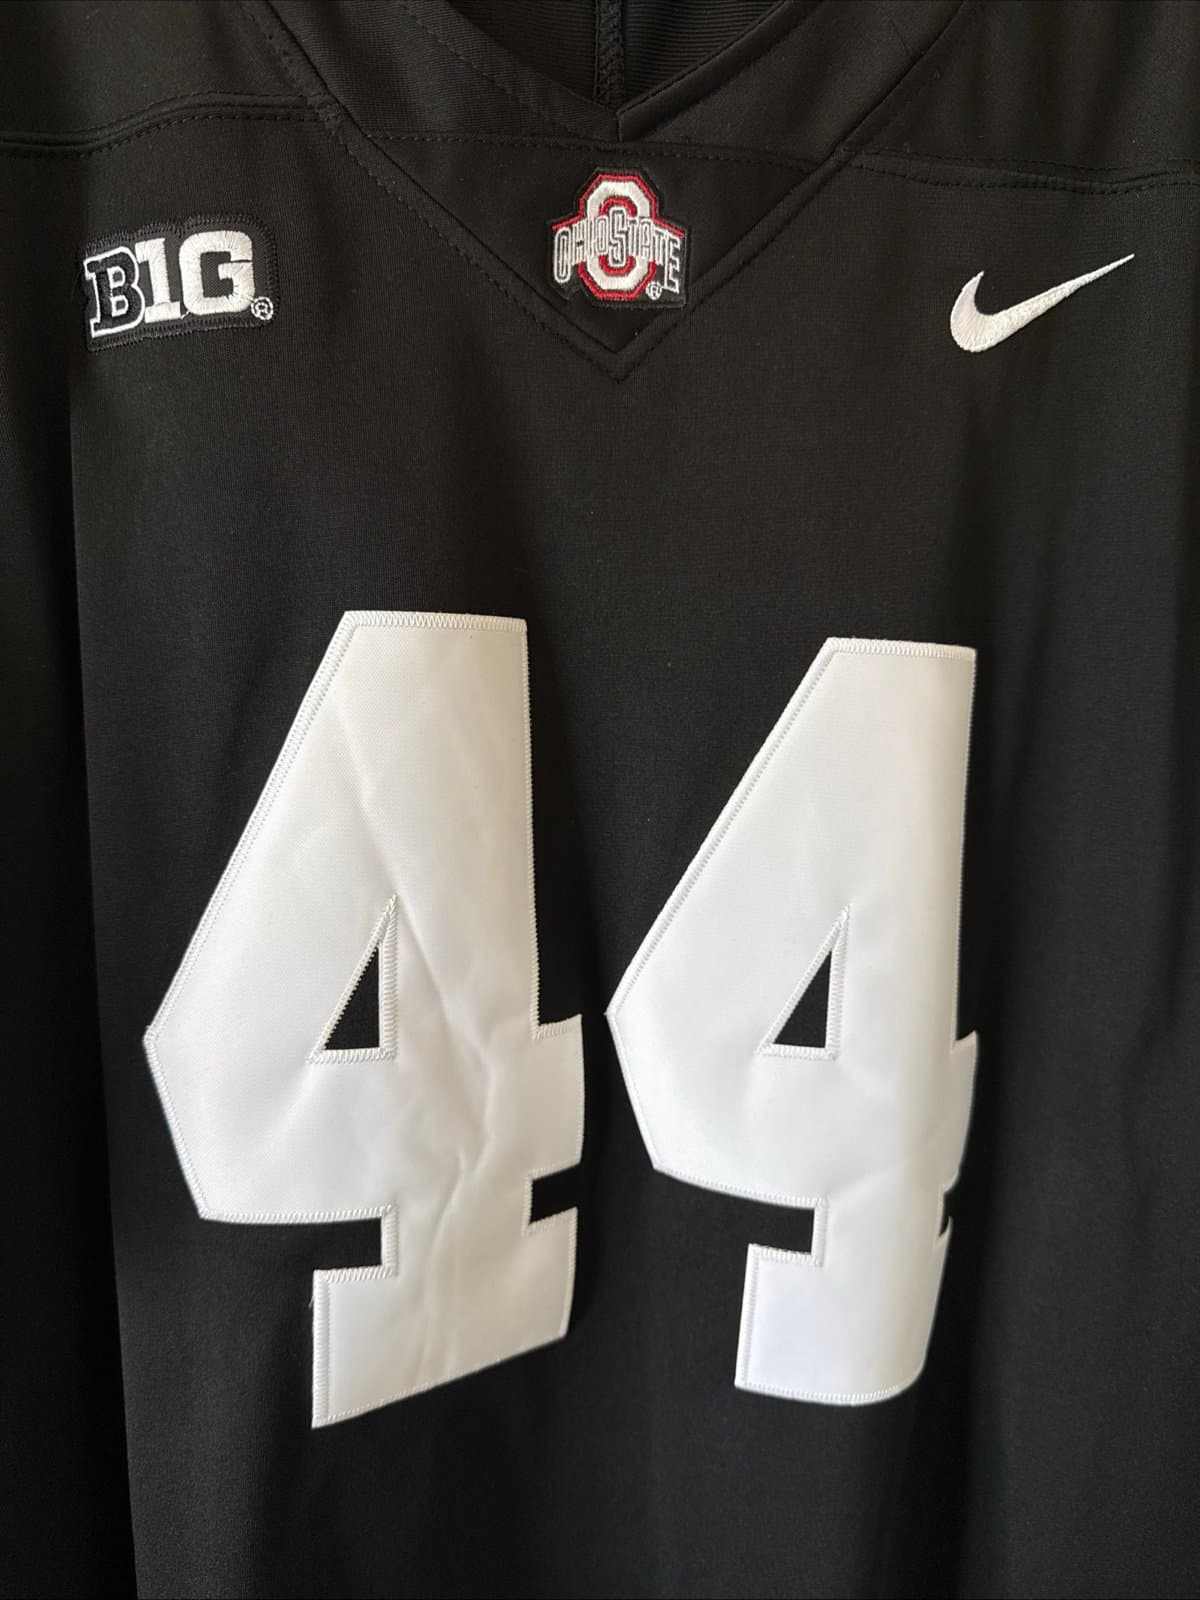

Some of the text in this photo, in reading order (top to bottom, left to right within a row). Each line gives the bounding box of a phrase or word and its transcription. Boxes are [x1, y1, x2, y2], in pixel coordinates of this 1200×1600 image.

[553, 206, 681, 294] OHIO STATE
[142, 609, 978, 1429] 44
